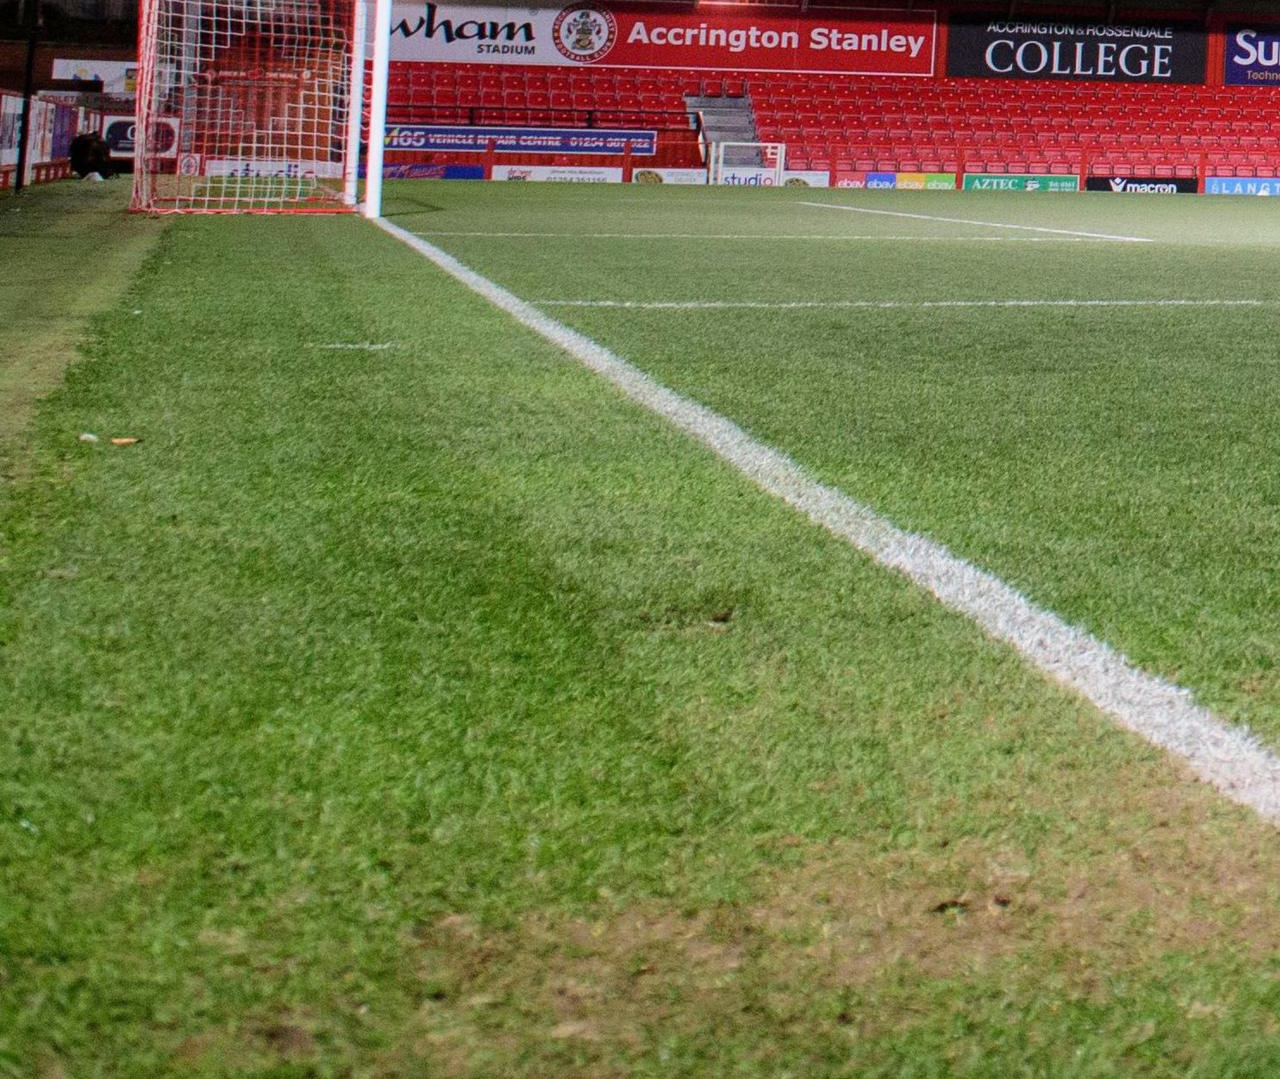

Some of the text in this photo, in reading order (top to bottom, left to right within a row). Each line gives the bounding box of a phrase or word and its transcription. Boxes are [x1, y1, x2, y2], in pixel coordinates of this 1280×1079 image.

[986, 21, 1173, 39] ACCRINGTON & ROSSENDALE
[627, 22, 925, 58] Accrington Stanley
[477, 44, 535, 55] STADIUM
[985, 39, 1172, 78] COLLEGE
[428, 134, 475, 145] VEHICLE
[520, 136, 562, 146] CENTRE
[724, 173, 774, 187] studio
[838, 179, 865, 189] ebay
[867, 180, 894, 189] ebay
[897, 180, 925, 190] ebay
[972, 178, 1018, 190] AZTEC
[1126, 182, 1177, 195] macron
